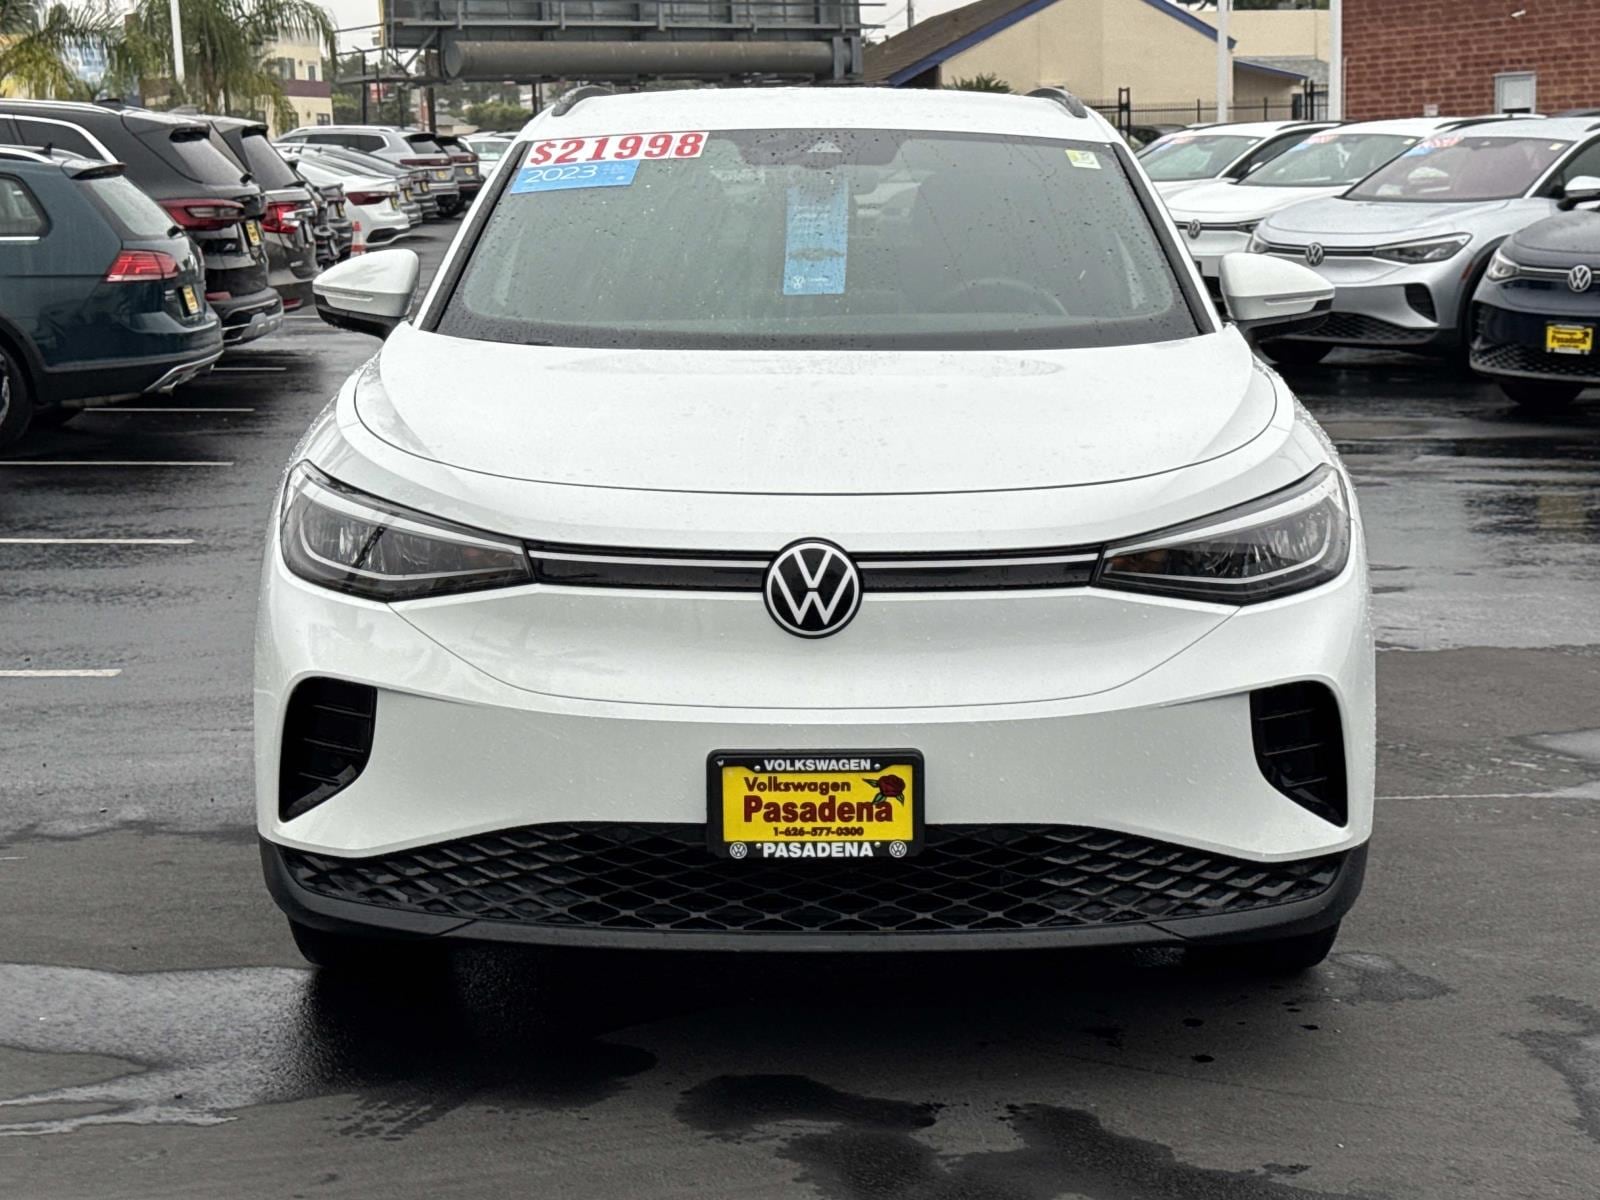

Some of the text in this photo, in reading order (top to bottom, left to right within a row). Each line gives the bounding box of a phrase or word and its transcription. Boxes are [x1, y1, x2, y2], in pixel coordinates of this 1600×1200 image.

[530, 133, 703, 165] $21998
[524, 164, 599, 184] 2023
[765, 541, 861, 637] VW
[764, 759, 871, 771] VOLKSWAGEN
[744, 776, 851, 795] Volkswagen
[743, 795, 893, 823] Pasadena
[763, 842, 873, 858] PASADENA
